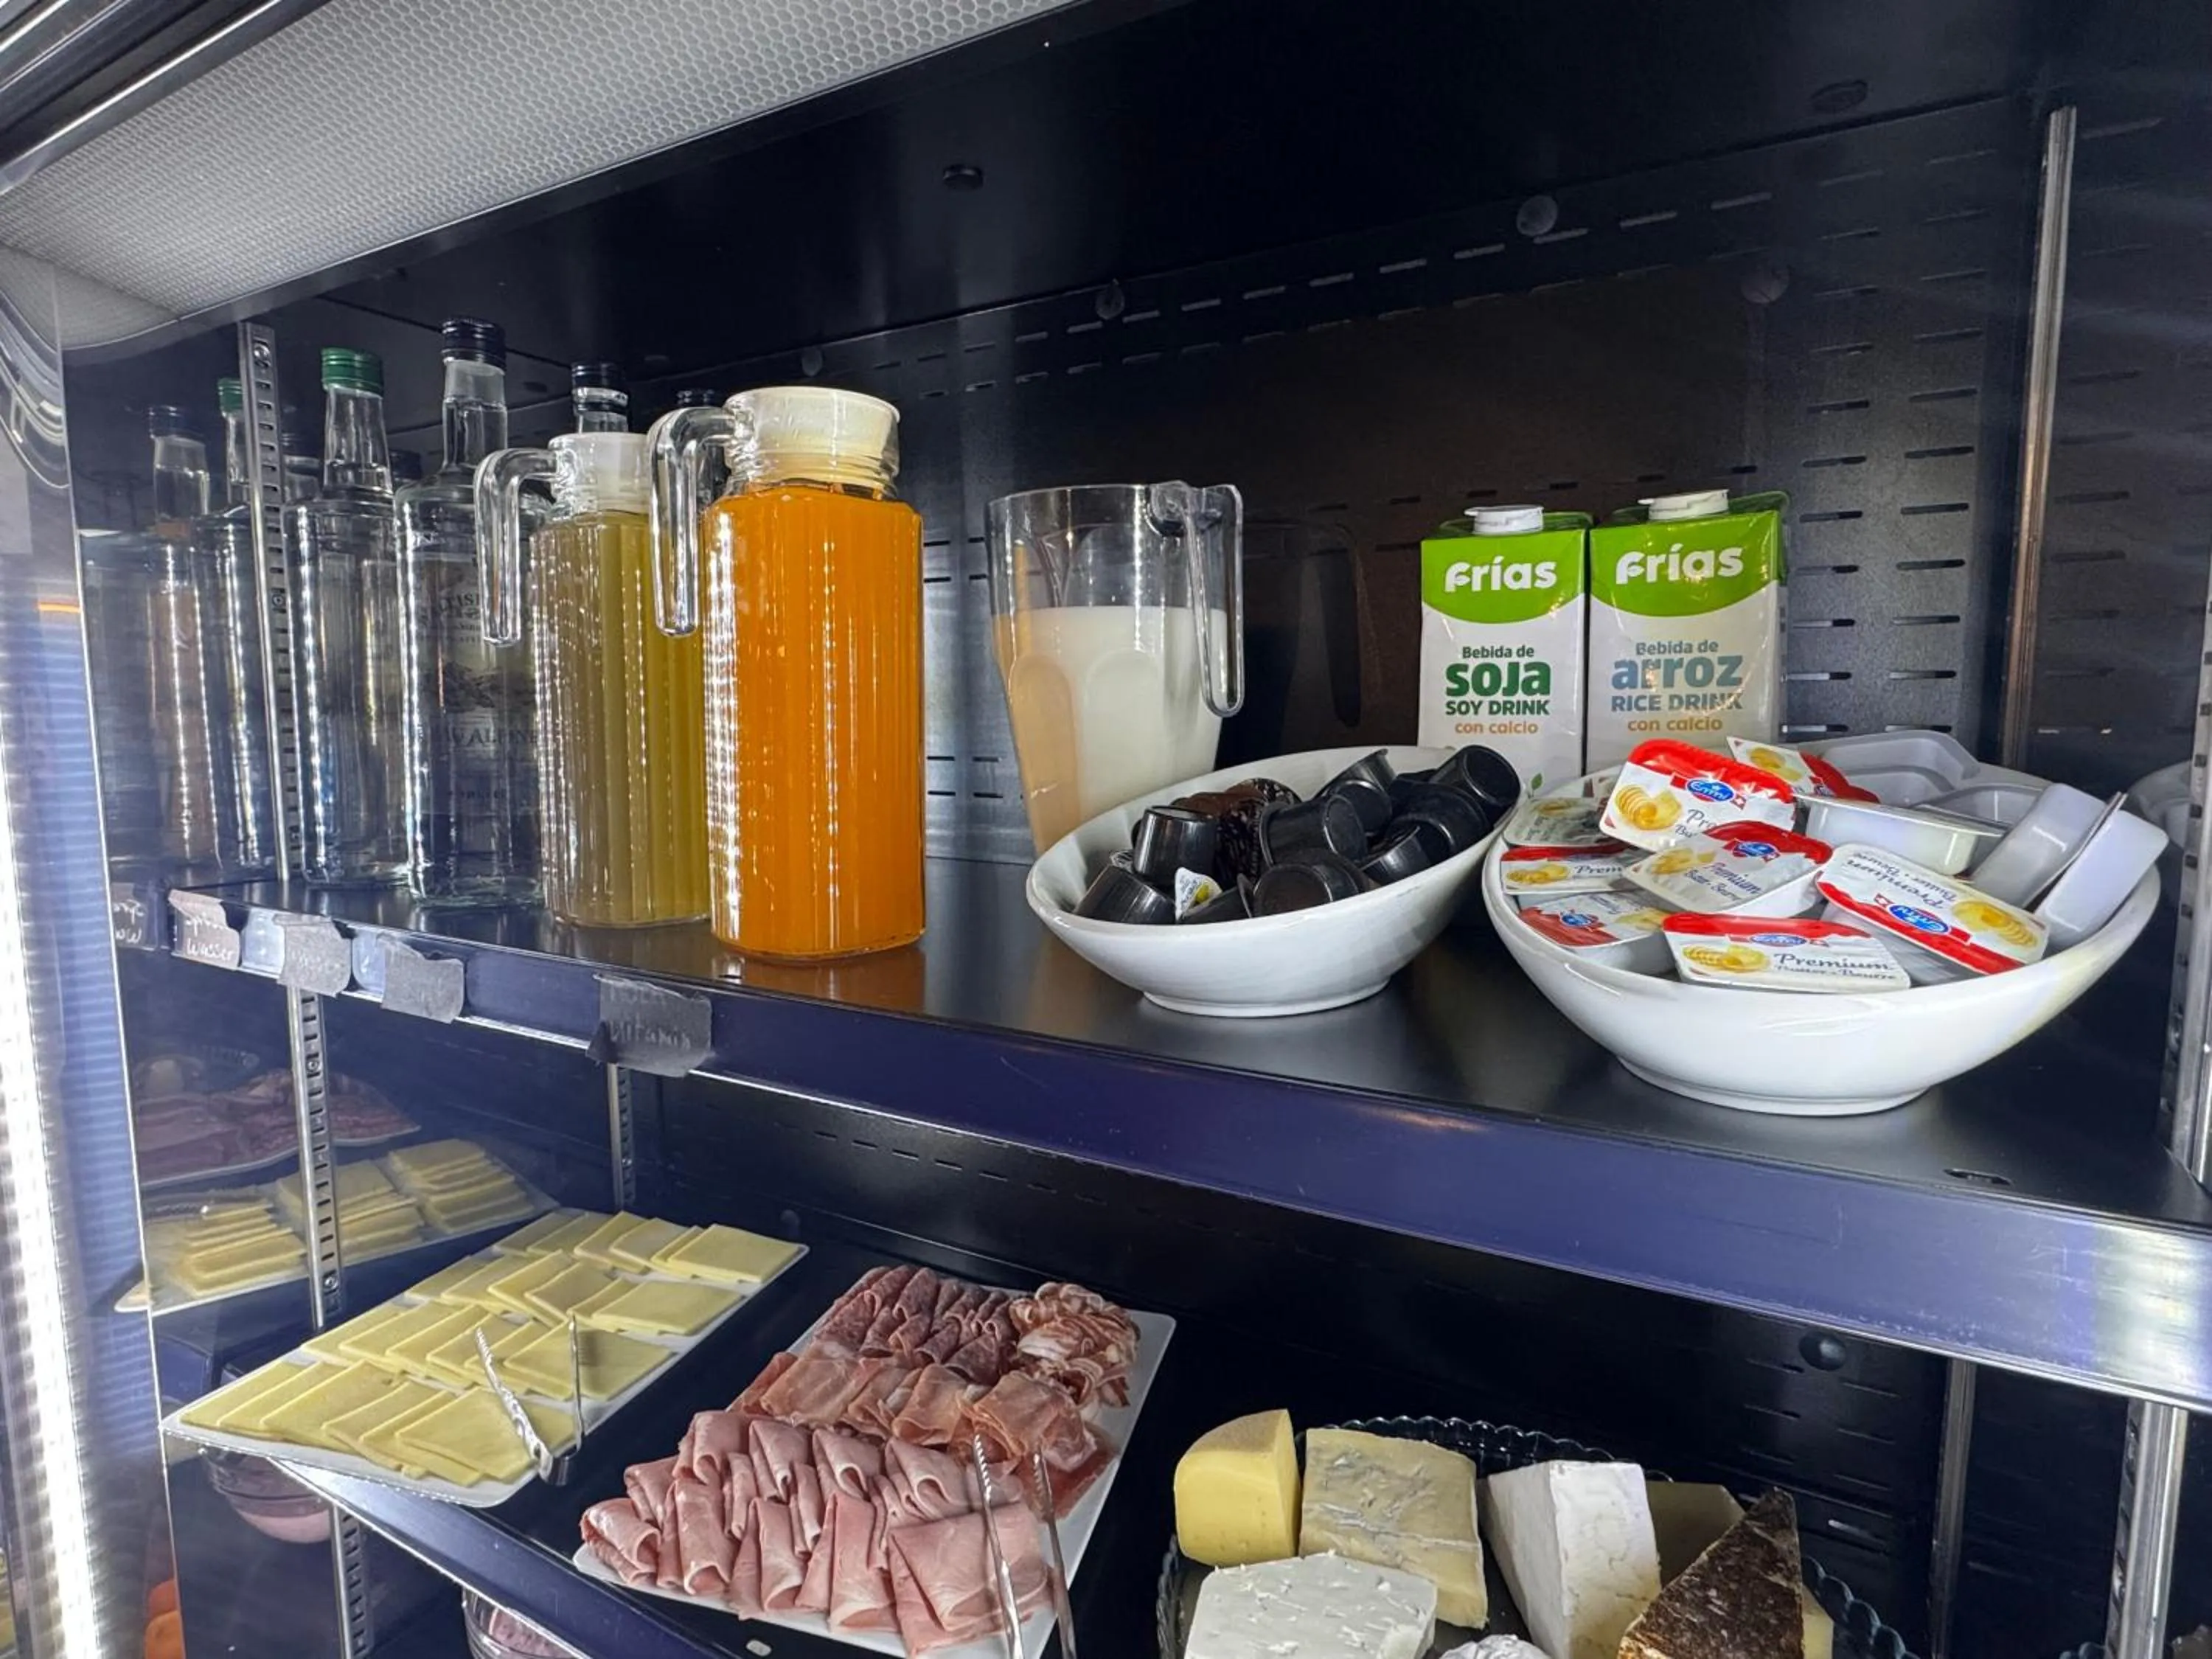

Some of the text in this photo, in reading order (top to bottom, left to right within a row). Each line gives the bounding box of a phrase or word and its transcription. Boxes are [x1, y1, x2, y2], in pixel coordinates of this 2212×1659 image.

[1462, 644, 1534, 659] Bebida de
[1635, 639, 1719, 655] Bebida de
[1445, 661, 1551, 697] soja
[1611, 655, 1744, 690] arroz
[1445, 700, 1551, 716] SOY DRINK
[1610, 691, 1744, 712] RICE DRINK
[1455, 720, 1539, 734] con calcio
[1627, 716, 1723, 732] con calcio
[1574, 865, 1622, 874] Prem
[1844, 858, 1944, 908] Premium
[1773, 953, 1890, 970] Premium
